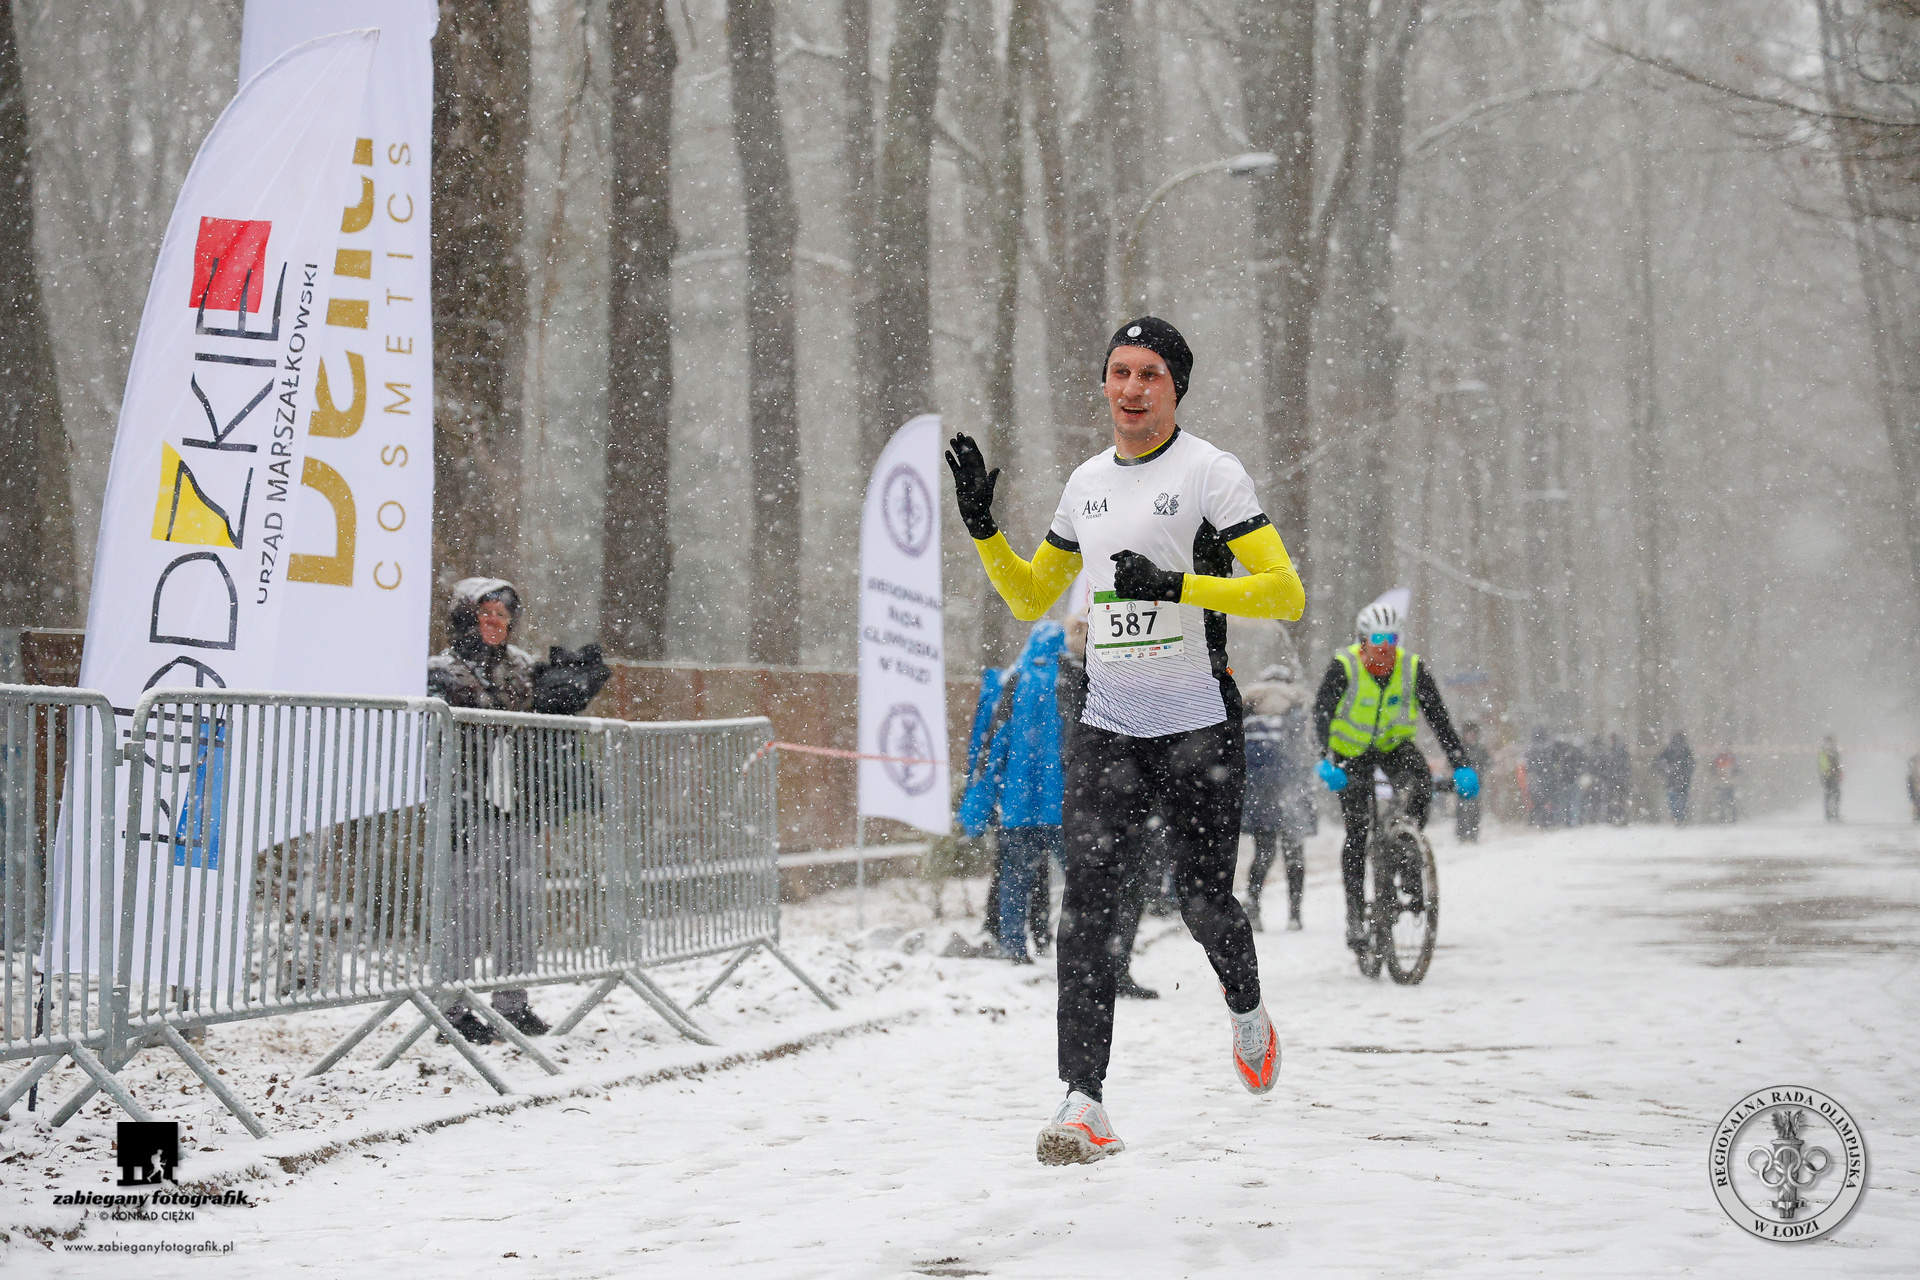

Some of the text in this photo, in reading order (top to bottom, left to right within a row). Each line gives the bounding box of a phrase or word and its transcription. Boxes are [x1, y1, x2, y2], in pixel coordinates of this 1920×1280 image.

[256, 262, 318, 605] URZĄD MARSZAŁKOWSKI
[374, 142, 413, 590] COSMETICS
[1082, 497, 1108, 516] A&A
[1110, 611, 1158, 638] 587
